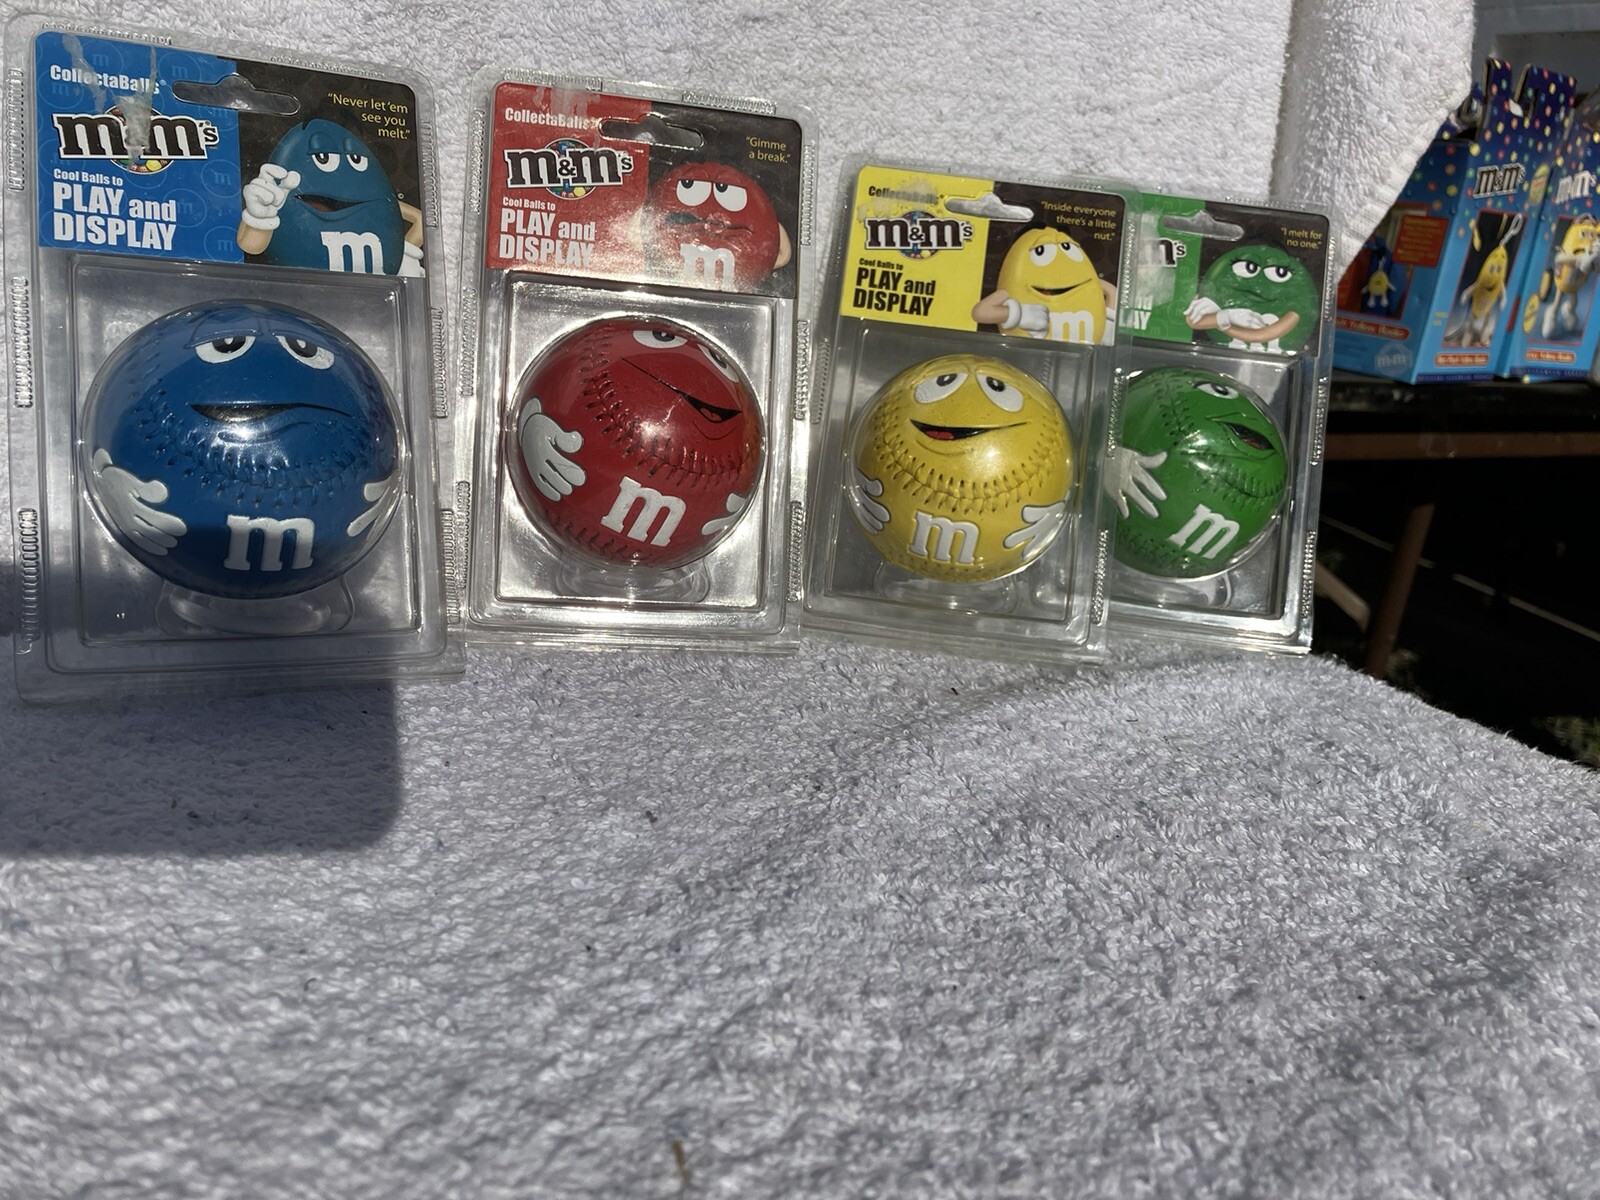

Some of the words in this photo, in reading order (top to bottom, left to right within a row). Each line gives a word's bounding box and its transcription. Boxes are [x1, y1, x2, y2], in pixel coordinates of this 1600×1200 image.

[361, 112, 382, 124] see
[383, 116, 406, 127] you
[52, 113, 220, 160] mm's
[748, 150, 756, 159] a
[53, 168, 79, 181] Cool
[81, 172, 110, 186] Balls
[112, 175, 123, 187] to
[53, 181, 124, 216] PLAY
[128, 198, 177, 223] and
[502, 196, 523, 207] Cool
[523, 200, 546, 211] Balls
[547, 202, 556, 212] to
[1073, 204, 1116, 218] everyone
[53, 211, 177, 251] DISPLAY
[500, 207, 556, 237] PLAY
[557, 221, 597, 242] and
[1087, 220, 1094, 228] a
[1095, 219, 1117, 230] little
[1288, 229, 1309, 239] melt
[1309, 230, 1323, 240] for
[499, 234, 595, 268] DISPLAY
[1286, 239, 1299, 247] no
[858, 257, 876, 267] Cool
[876, 260, 896, 270] Balls
[894, 262, 904, 271] to
[855, 266, 903, 291] PLAY
[903, 279, 937, 297] and
[852, 287, 934, 317] DISPLAY
[600, 475, 687, 547] m
[223, 514, 316, 572] m
[907, 511, 979, 565] m
[1167, 503, 1240, 560] m
